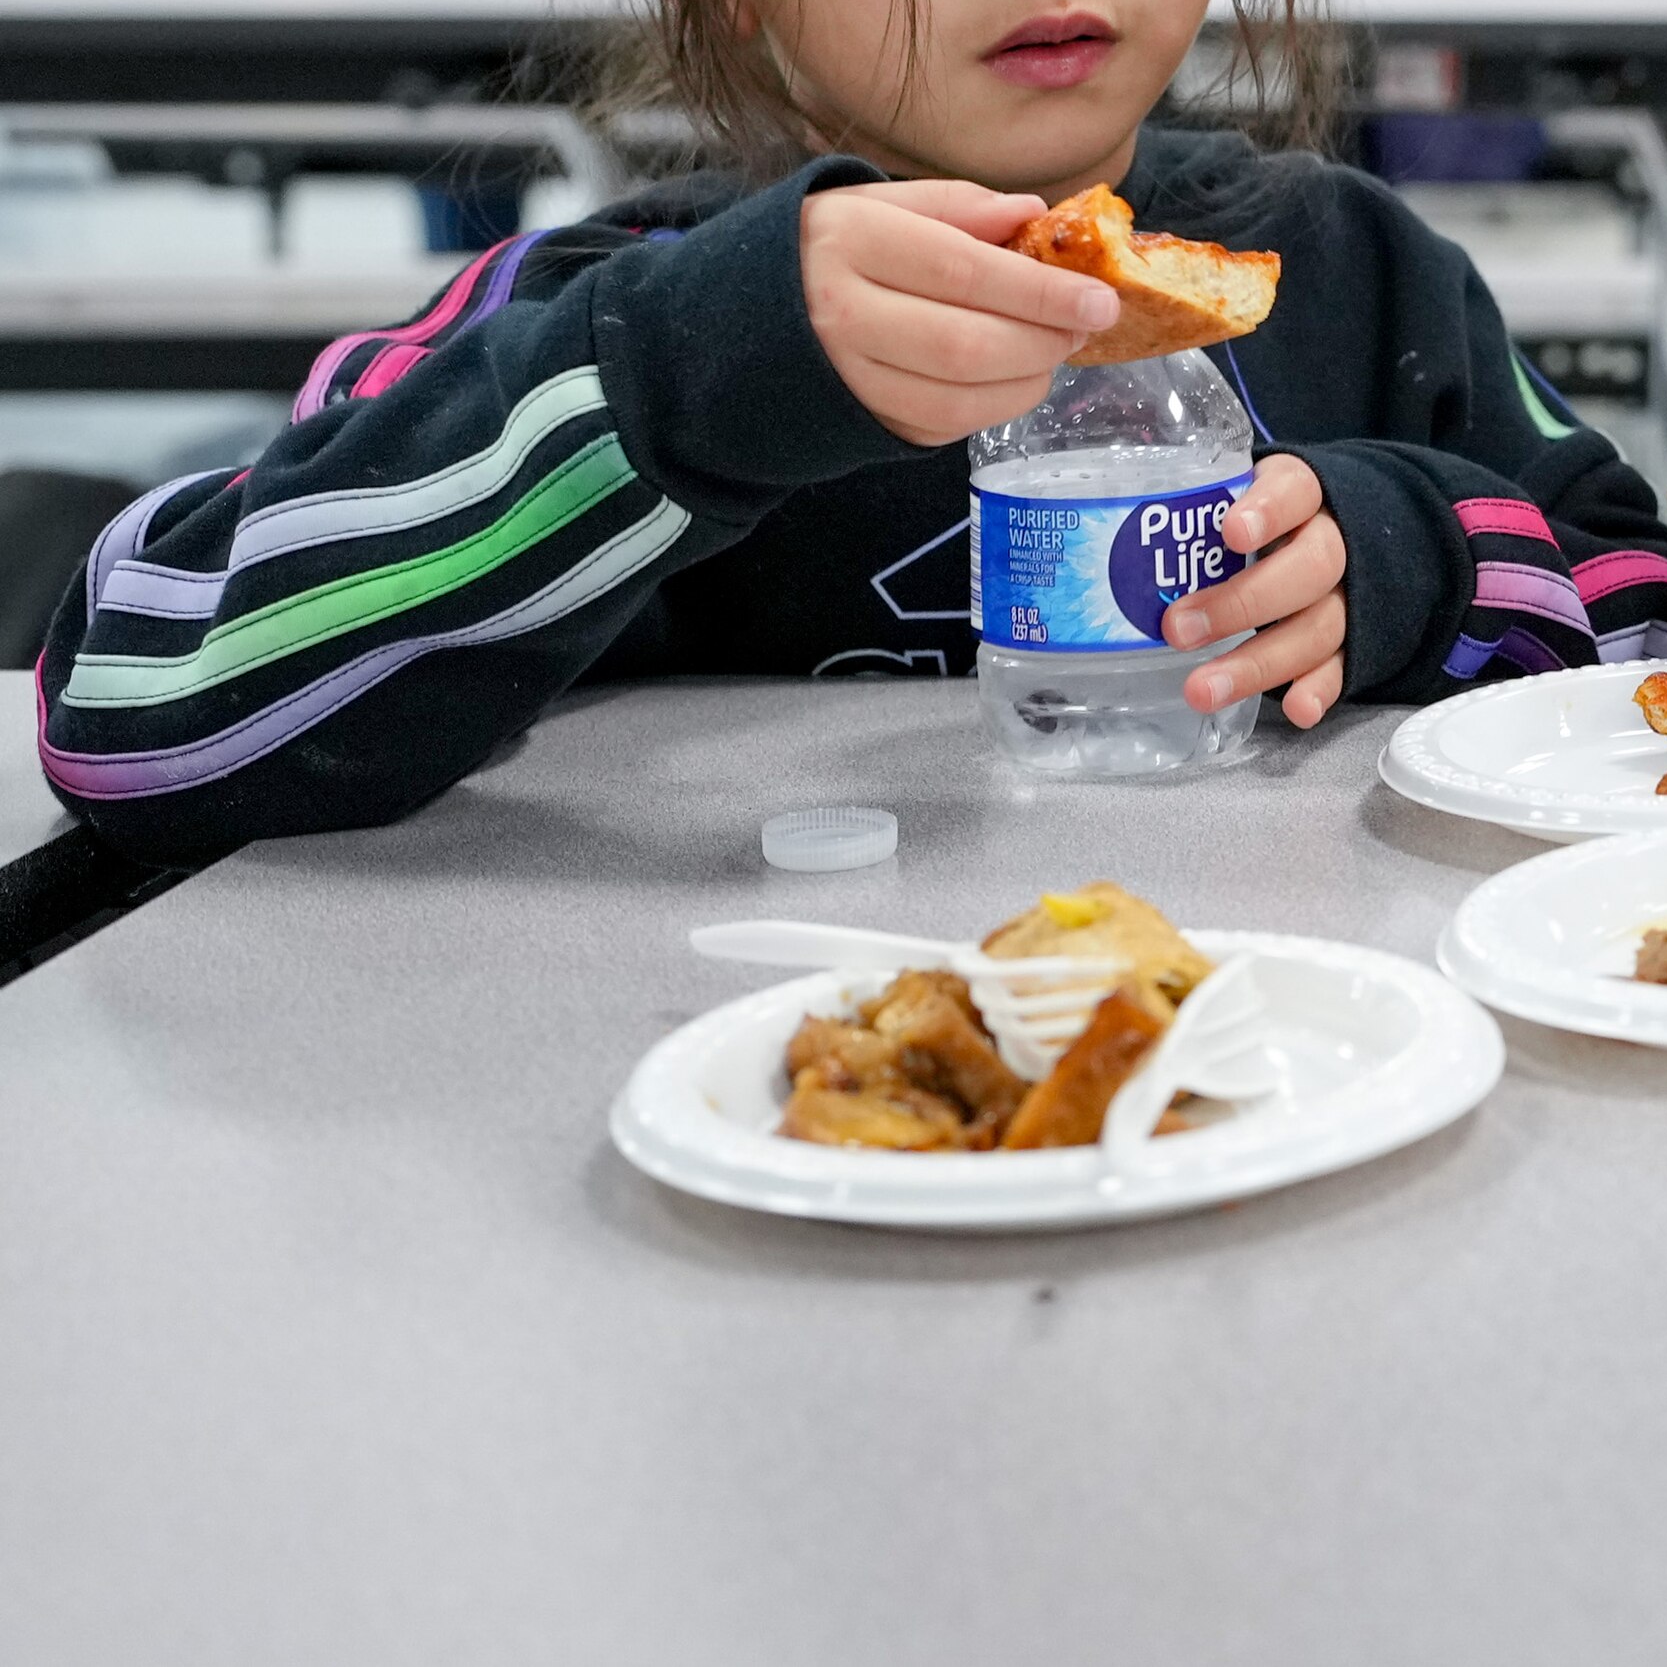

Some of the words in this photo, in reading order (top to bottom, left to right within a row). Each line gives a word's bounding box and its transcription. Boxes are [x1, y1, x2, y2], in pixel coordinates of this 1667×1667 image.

[1009, 507, 1080, 530] PURIFIED
[1009, 529, 1064, 550] WATER
[1009, 549, 1042, 562] ENHANCED
[1042, 550, 1063, 563] WITH
[1009, 561, 1040, 574] MINERALS
[1041, 563, 1056, 575] FOR
[1154, 540, 1225, 593] Life
[1032, 576, 1055, 587] TASTE
[1011, 606, 1017, 623] 8
[1017, 607, 1027, 624] FL
[1028, 608, 1039, 625] OZ
[1012, 624, 1028, 642] (237
[1029, 626, 1048, 644] mL)
